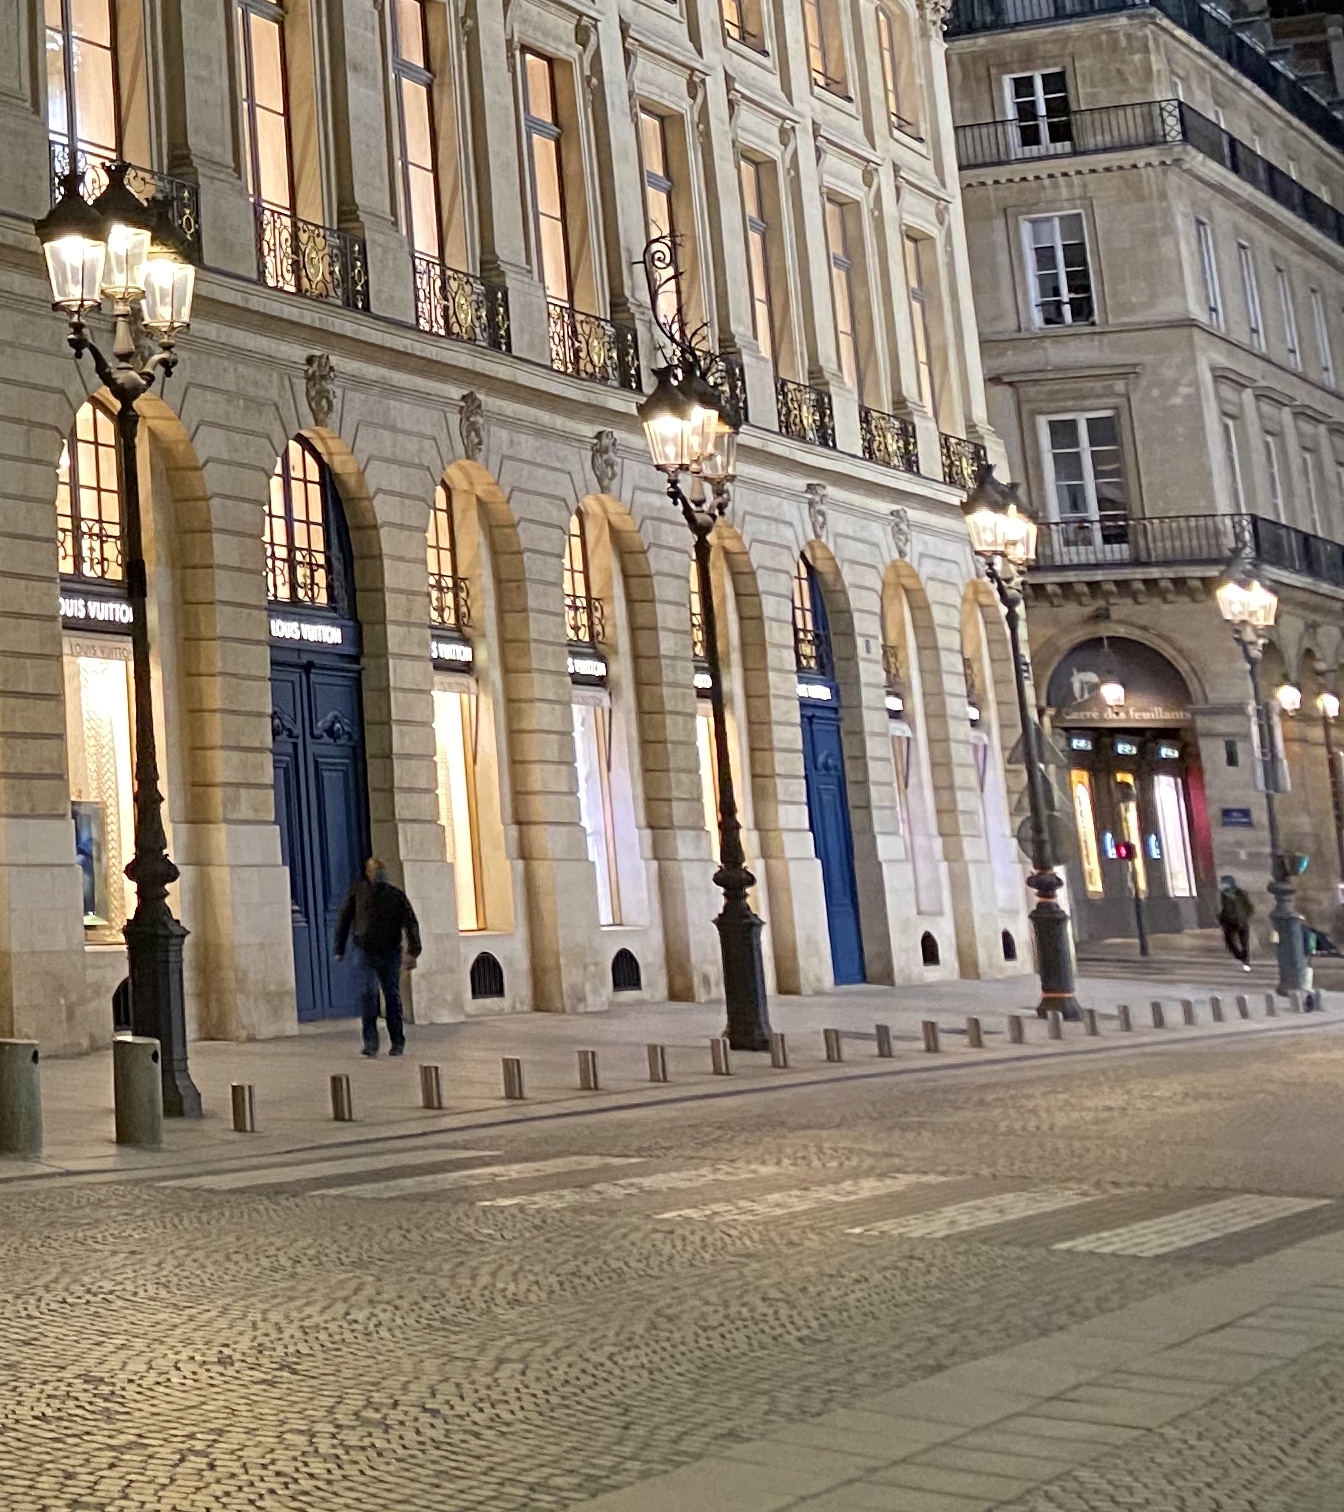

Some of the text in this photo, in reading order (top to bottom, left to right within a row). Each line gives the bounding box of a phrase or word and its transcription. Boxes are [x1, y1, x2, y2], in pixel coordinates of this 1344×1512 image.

[58, 596, 87, 619] OUIS
[270, 619, 301, 640] LOUIS
[69, 638, 97, 656] LOUIS
